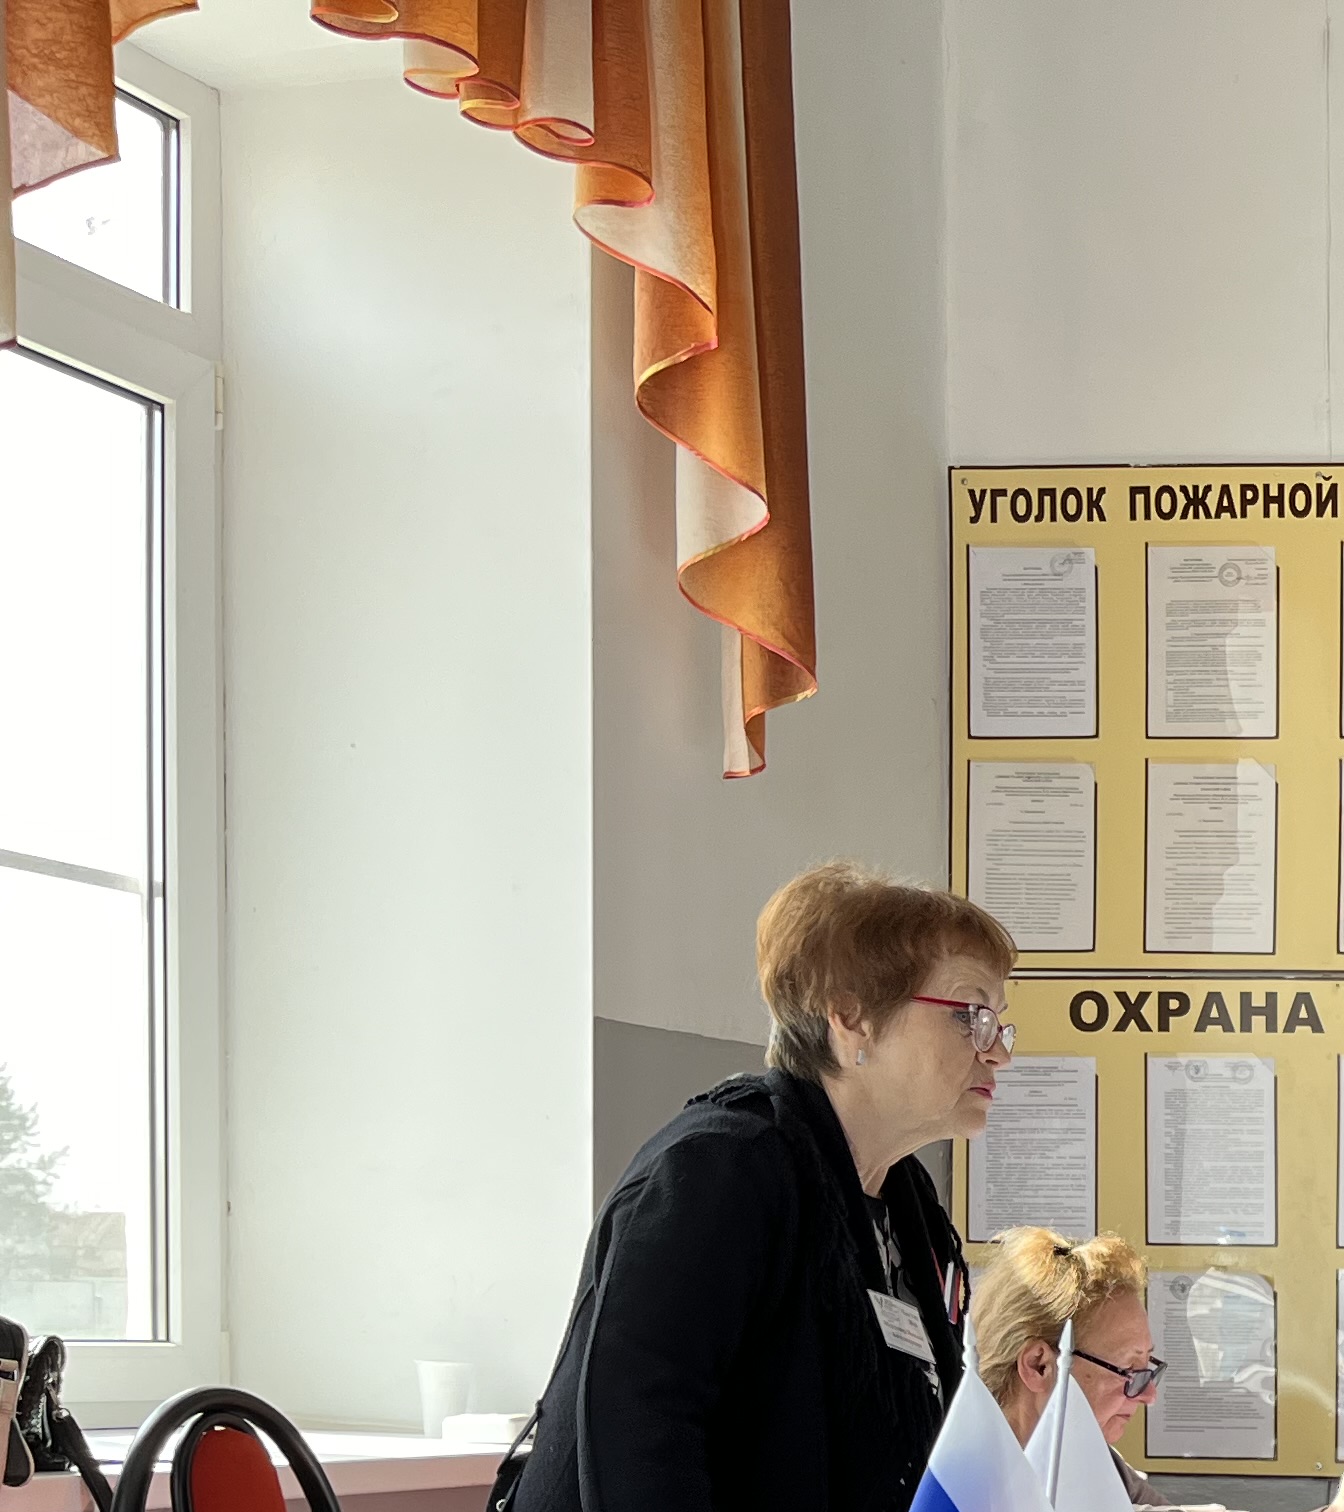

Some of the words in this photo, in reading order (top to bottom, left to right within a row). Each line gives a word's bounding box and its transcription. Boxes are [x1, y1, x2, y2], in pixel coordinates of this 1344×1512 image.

[968, 486, 1107, 524] УГОЛОК
[1129, 475, 1339, 521] ПОЖАРНОЙ
[1069, 990, 1324, 1034] ОХРАНА
